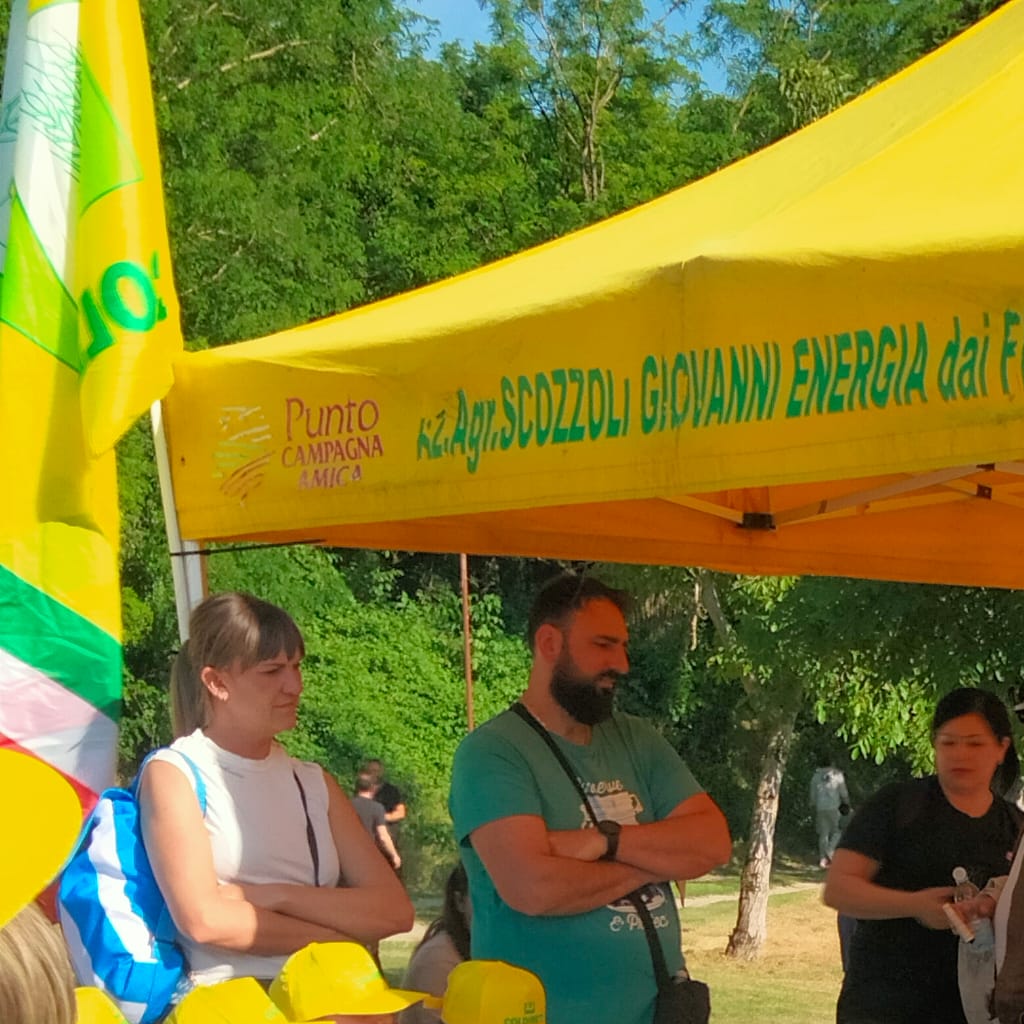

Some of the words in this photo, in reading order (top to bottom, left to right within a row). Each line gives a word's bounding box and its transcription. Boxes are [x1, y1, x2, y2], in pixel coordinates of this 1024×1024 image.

[640, 341, 781, 434] GIOVANNI
[785, 321, 928, 419] ENERGIA
[937, 311, 989, 402] dai
[286, 394, 379, 442] Punto
[281, 434, 383, 468] CAMPAGNA
[298, 464, 362, 490] AMICA
